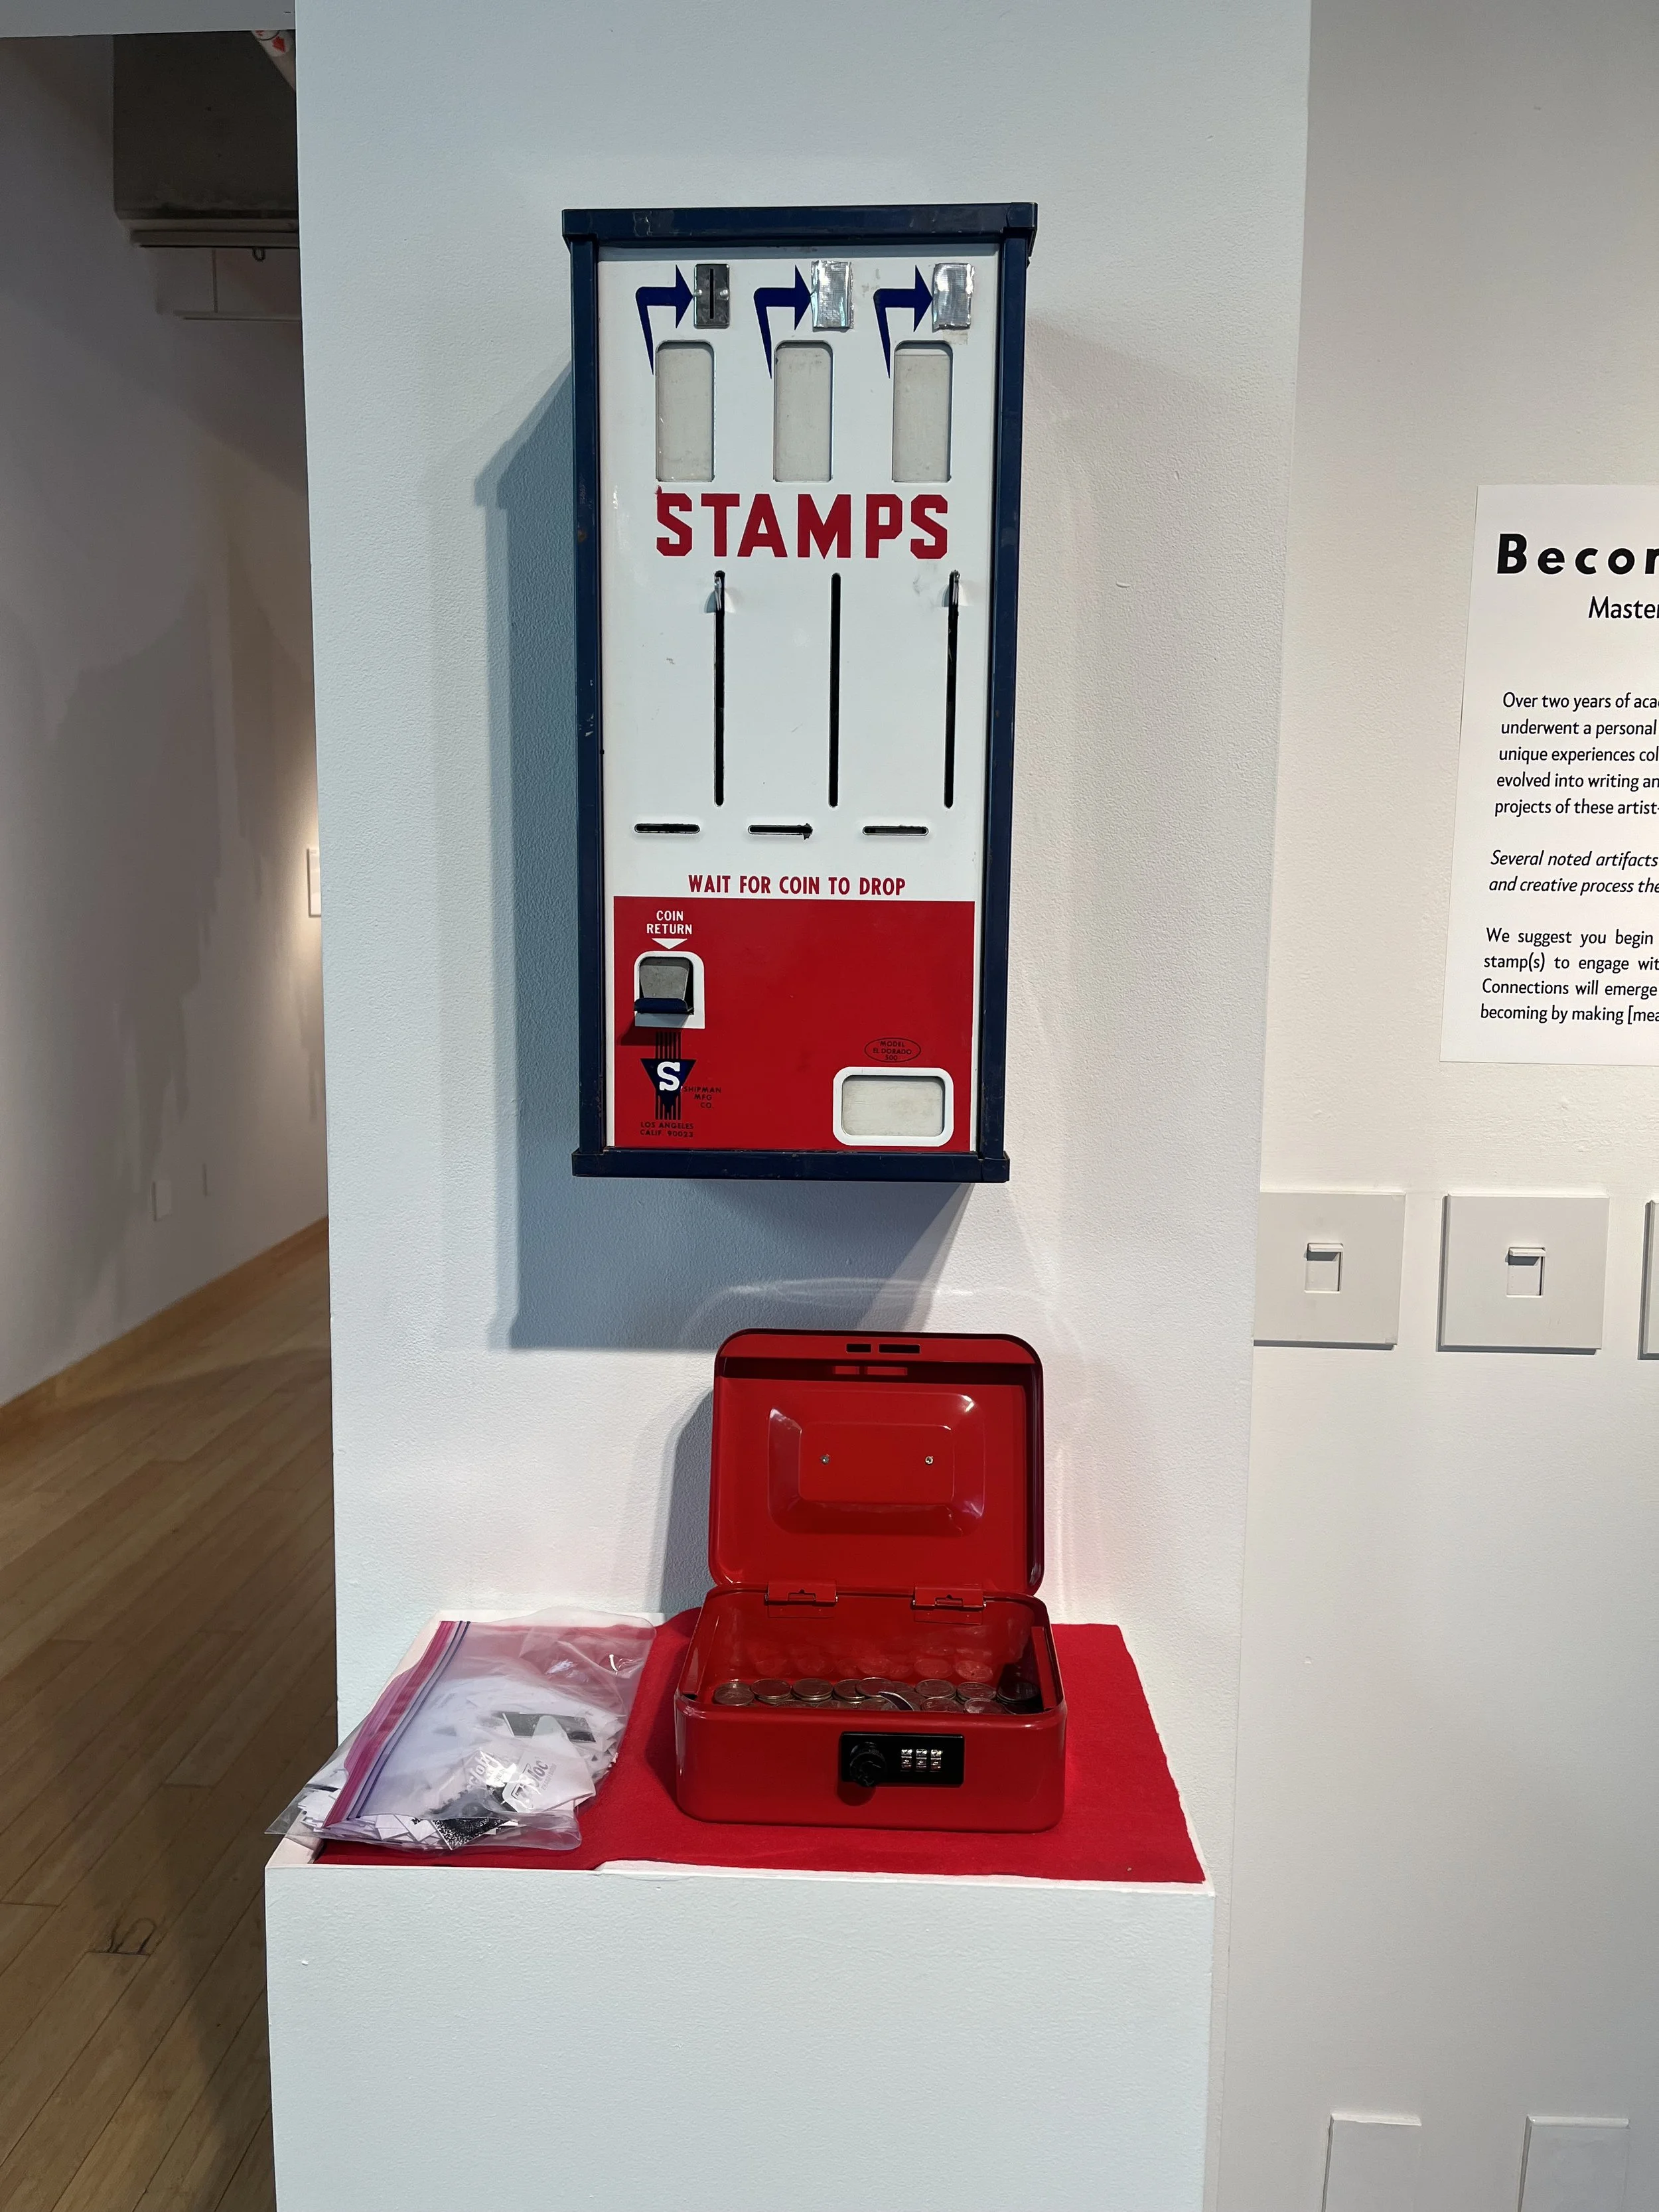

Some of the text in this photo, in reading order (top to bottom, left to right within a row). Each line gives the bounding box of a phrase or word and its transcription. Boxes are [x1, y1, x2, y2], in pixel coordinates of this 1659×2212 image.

[656, 491, 948, 559] STAMPS
[1588, 595, 1659, 619] Maste
[1502, 692, 1659, 712] Over two years of aca
[1501, 718, 1657, 739] underwent a personal
[1499, 746, 1548, 765] unique
[1551, 747, 1635, 765] experiences
[1496, 771, 1551, 787] evolved
[1554, 773, 1584, 788] into
[1587, 773, 1640, 792] writing
[1494, 799, 1551, 818] projects
[1555, 798, 1571, 814] of
[1573, 798, 1614, 814] these
[1490, 849, 1658, 871] Several noted artifacts
[688, 874, 906, 896] WAIT FOR COIN TO DROP
[1488, 875, 1518, 891] and
[1520, 877, 1578, 892] creative
[1579, 882, 1634, 896] process
[656, 910, 684, 922] COIN
[646, 923, 692, 935] RETURN
[1486, 927, 1654, 949] We suggest you begin
[1484, 952, 1545, 972] stamp(s)
[1553, 956, 1570, 969] to
[1578, 959, 1629, 974] engage
[1482, 978, 1658, 1000] Connections will emerge
[1480, 1003, 1548, 1024] becoming
[1551, 1004, 1569, 1024] by
[1571, 1005, 1624, 1025] making
[656, 1061, 681, 1091] S
